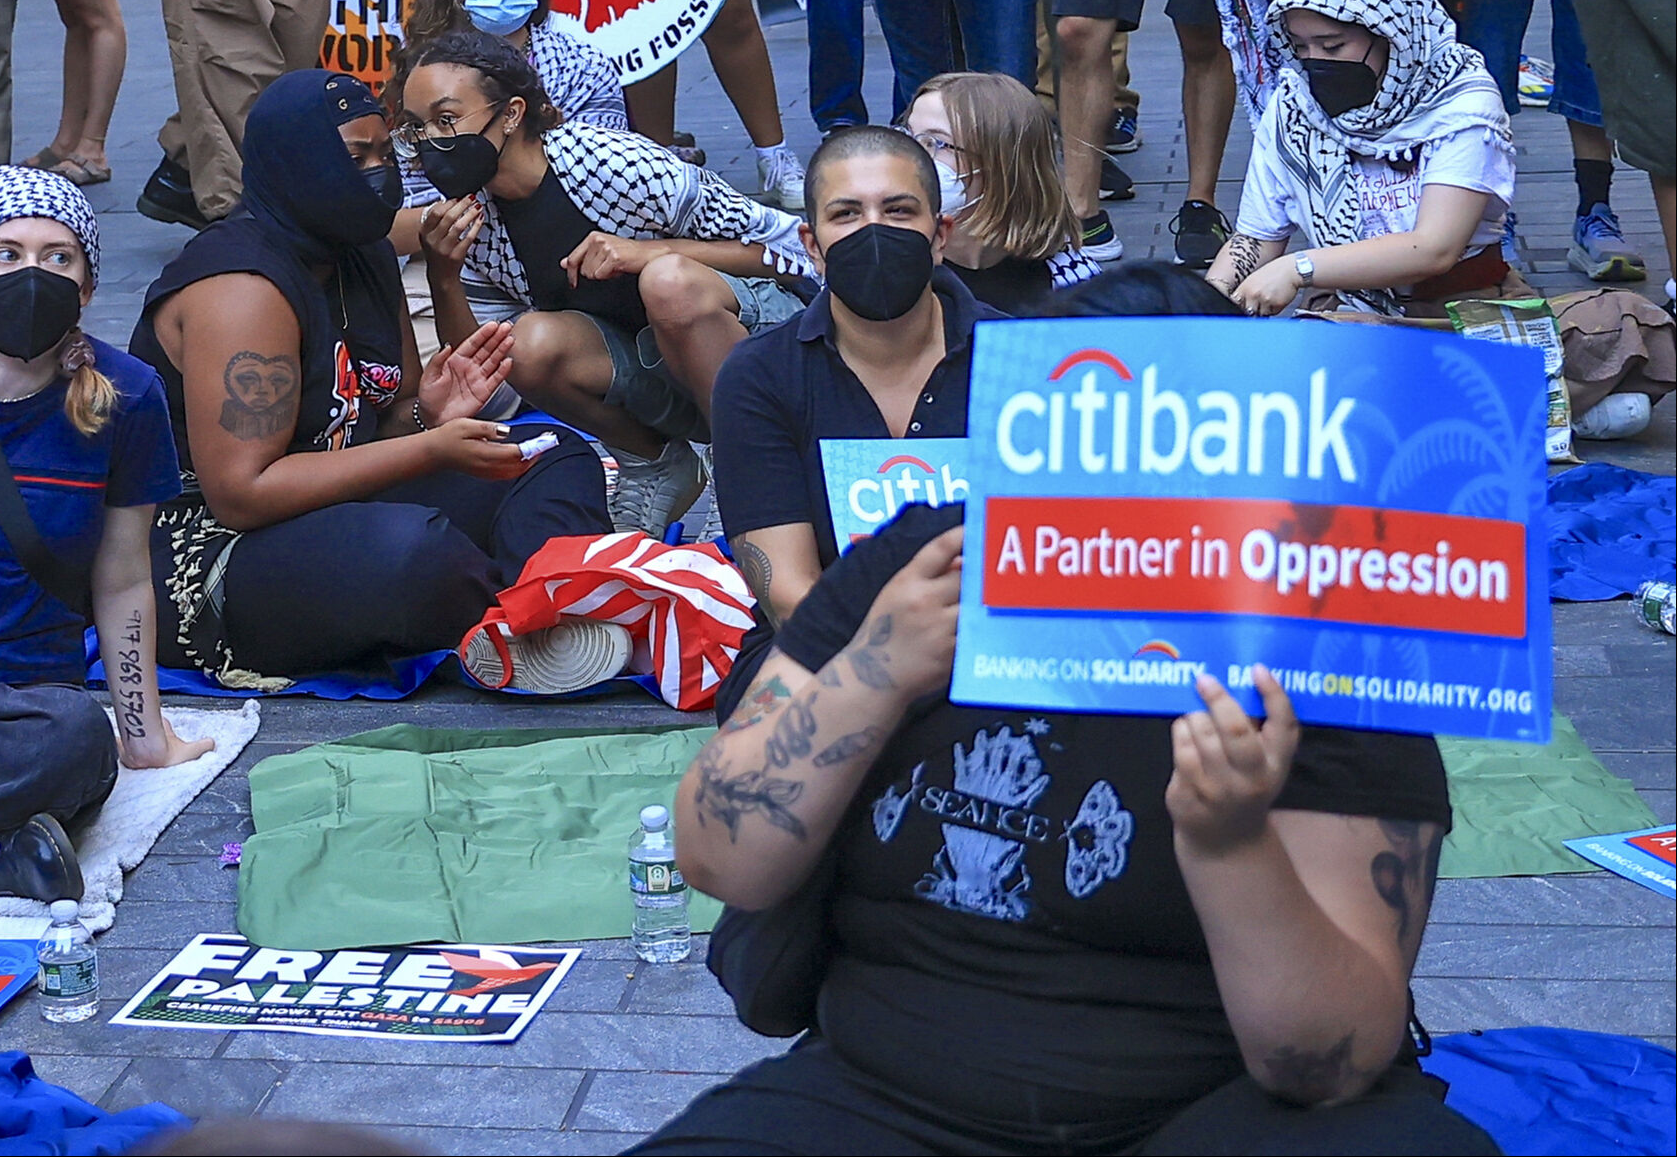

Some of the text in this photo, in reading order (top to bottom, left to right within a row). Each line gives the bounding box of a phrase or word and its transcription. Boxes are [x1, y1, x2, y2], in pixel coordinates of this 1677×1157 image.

[996, 363, 1357, 483] citibank
[997, 525, 1510, 603] A Partner in Oppression
[974, 654, 1205, 685] BANKING ON SOLIDARITY
[177, 943, 456, 990] FREE
[166, 1001, 258, 1015] CEASEFIRE
[315, 1009, 360, 1019] TEXT
[361, 1011, 408, 1022] GAZA
[411, 1015, 431, 1024] to
[168, 978, 531, 1016] PALESTINE
[321, 1019, 379, 1029] CHANGE
